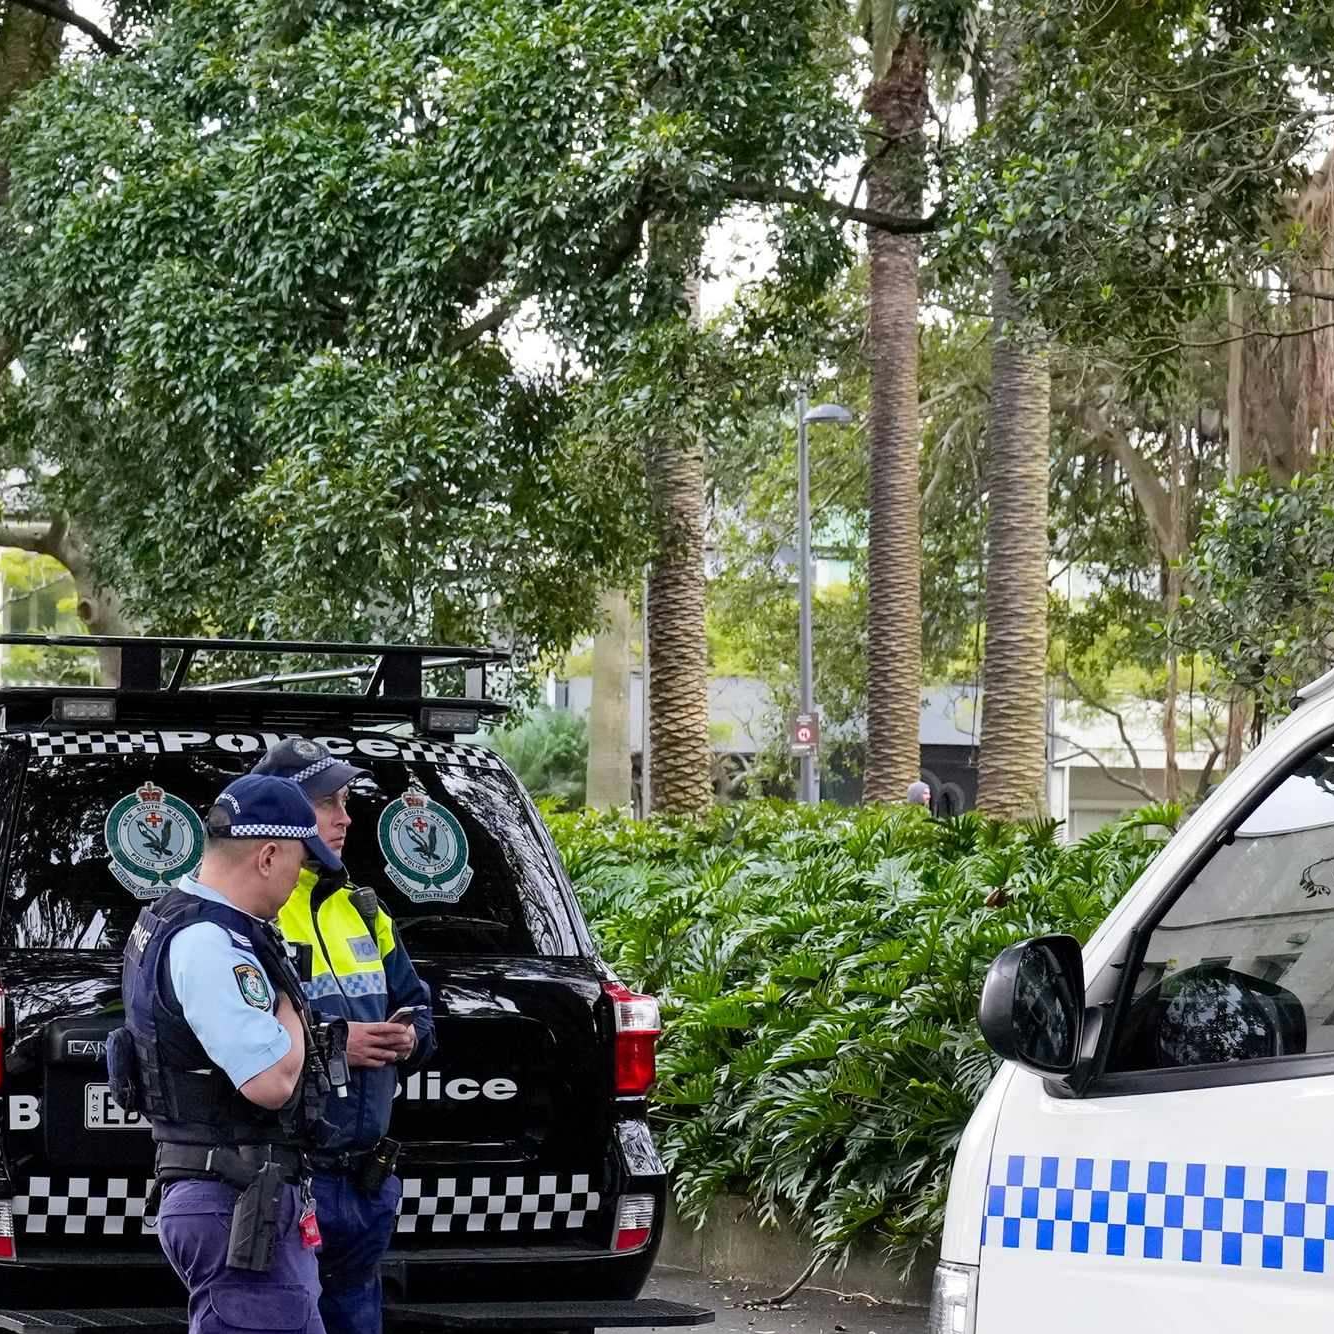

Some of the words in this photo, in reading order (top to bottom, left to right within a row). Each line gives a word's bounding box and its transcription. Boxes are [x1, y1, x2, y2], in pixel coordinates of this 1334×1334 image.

[160, 731, 400, 757] Polce
[123, 813, 133, 827] NEW
[136, 804, 160, 812] SOUTH
[166, 809, 186, 827] WALES
[394, 818, 402, 832] NEW
[404, 809, 425, 817] SOUTH
[430, 814, 449, 832] WALES
[131, 853, 155, 868] POLICE
[164, 853, 185, 867] FORCE
[403, 856, 426, 872] POLICE
[433, 859, 451, 872] FORCE
[68, 1040, 108, 1054] LAN
[392, 1071, 518, 1101] lice
[9, 1095, 41, 1130] B
[91, 1093, 100, 1123] NSW
